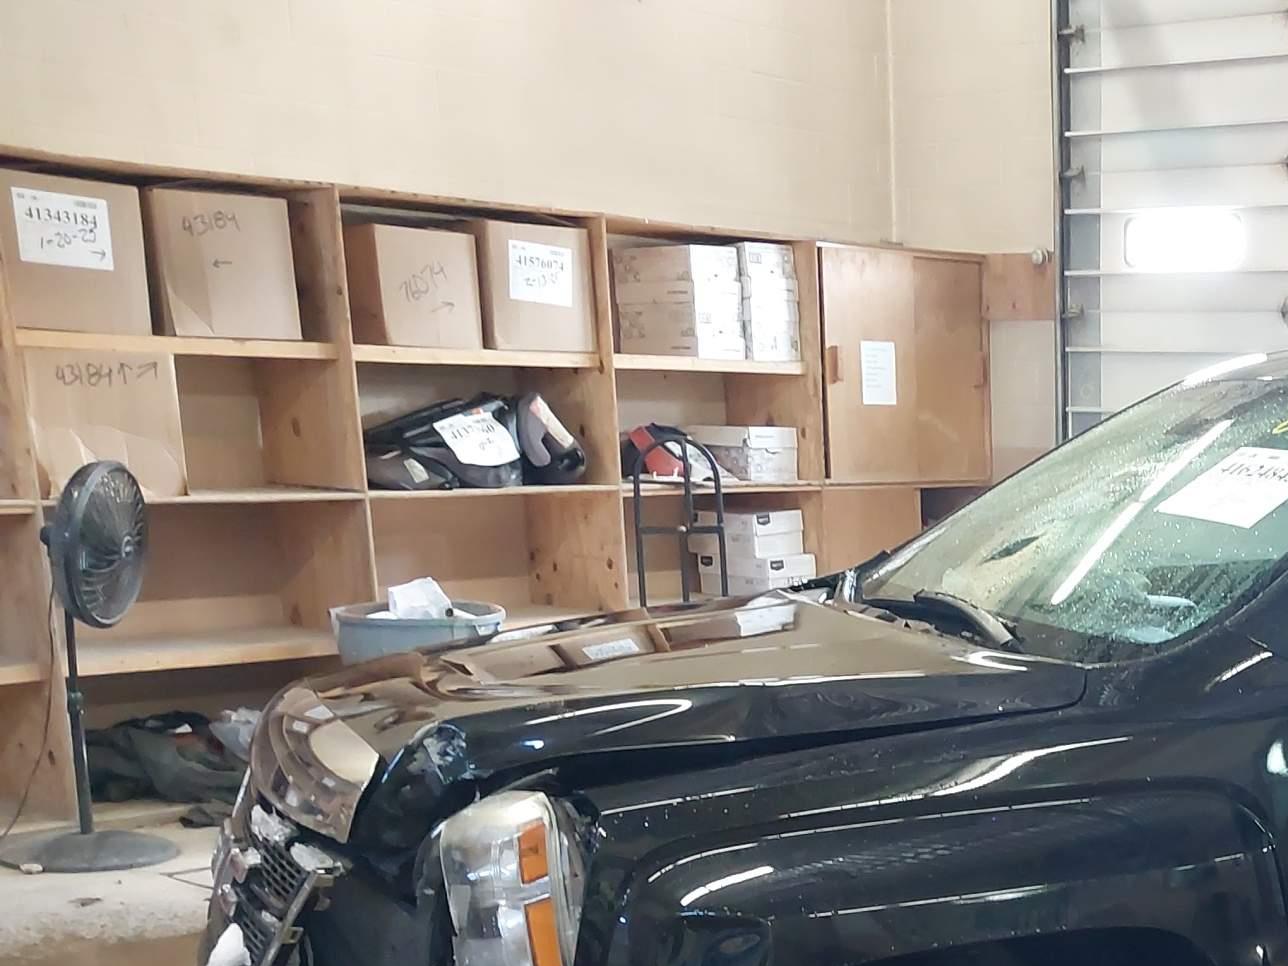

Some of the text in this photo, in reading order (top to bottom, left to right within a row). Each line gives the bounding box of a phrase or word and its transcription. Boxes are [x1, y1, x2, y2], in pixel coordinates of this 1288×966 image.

[24, 205, 98, 229] 41343184
[181, 210, 240, 238] 43184
[515, 255, 564, 272] 41576074
[56, 361, 113, 388] 43184
